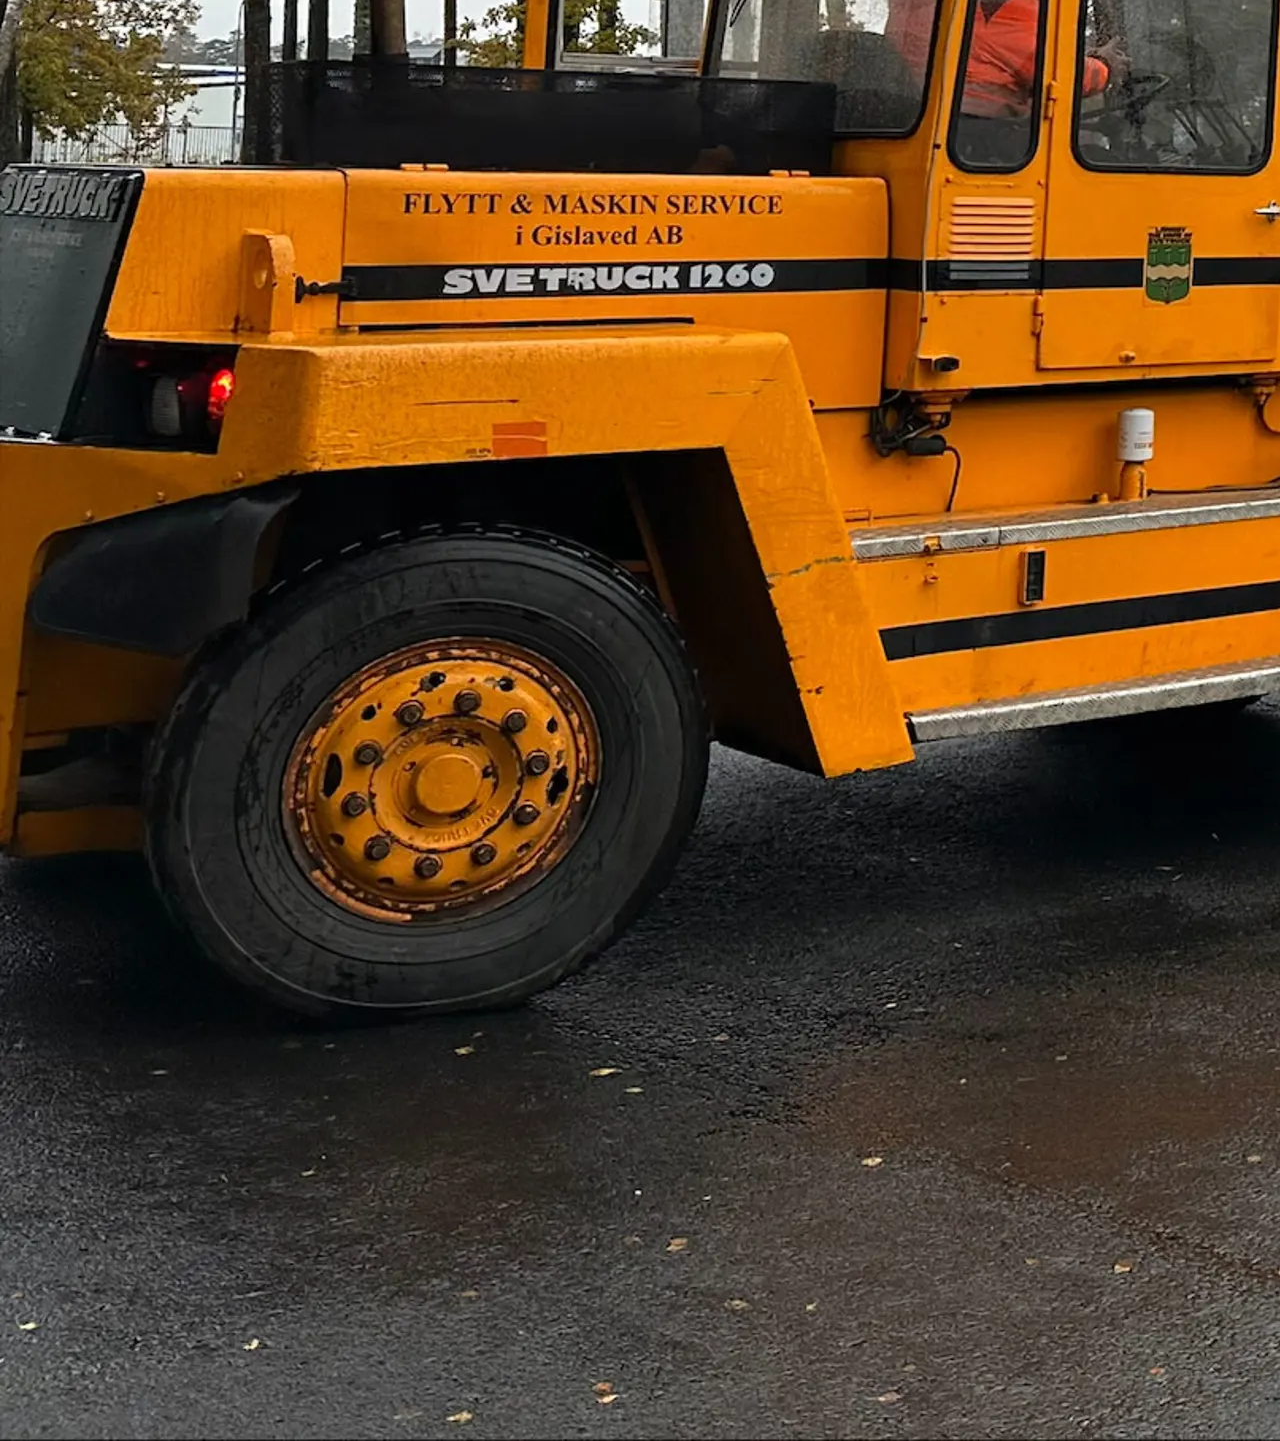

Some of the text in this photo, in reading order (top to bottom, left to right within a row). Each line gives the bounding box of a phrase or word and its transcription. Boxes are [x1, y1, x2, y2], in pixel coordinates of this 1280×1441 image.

[402, 192, 783, 215] FLYTT & MASKIN SERVICE
[515, 224, 684, 246] i Gislaved AB
[442, 263, 775, 295] SVETRUCK 1260
